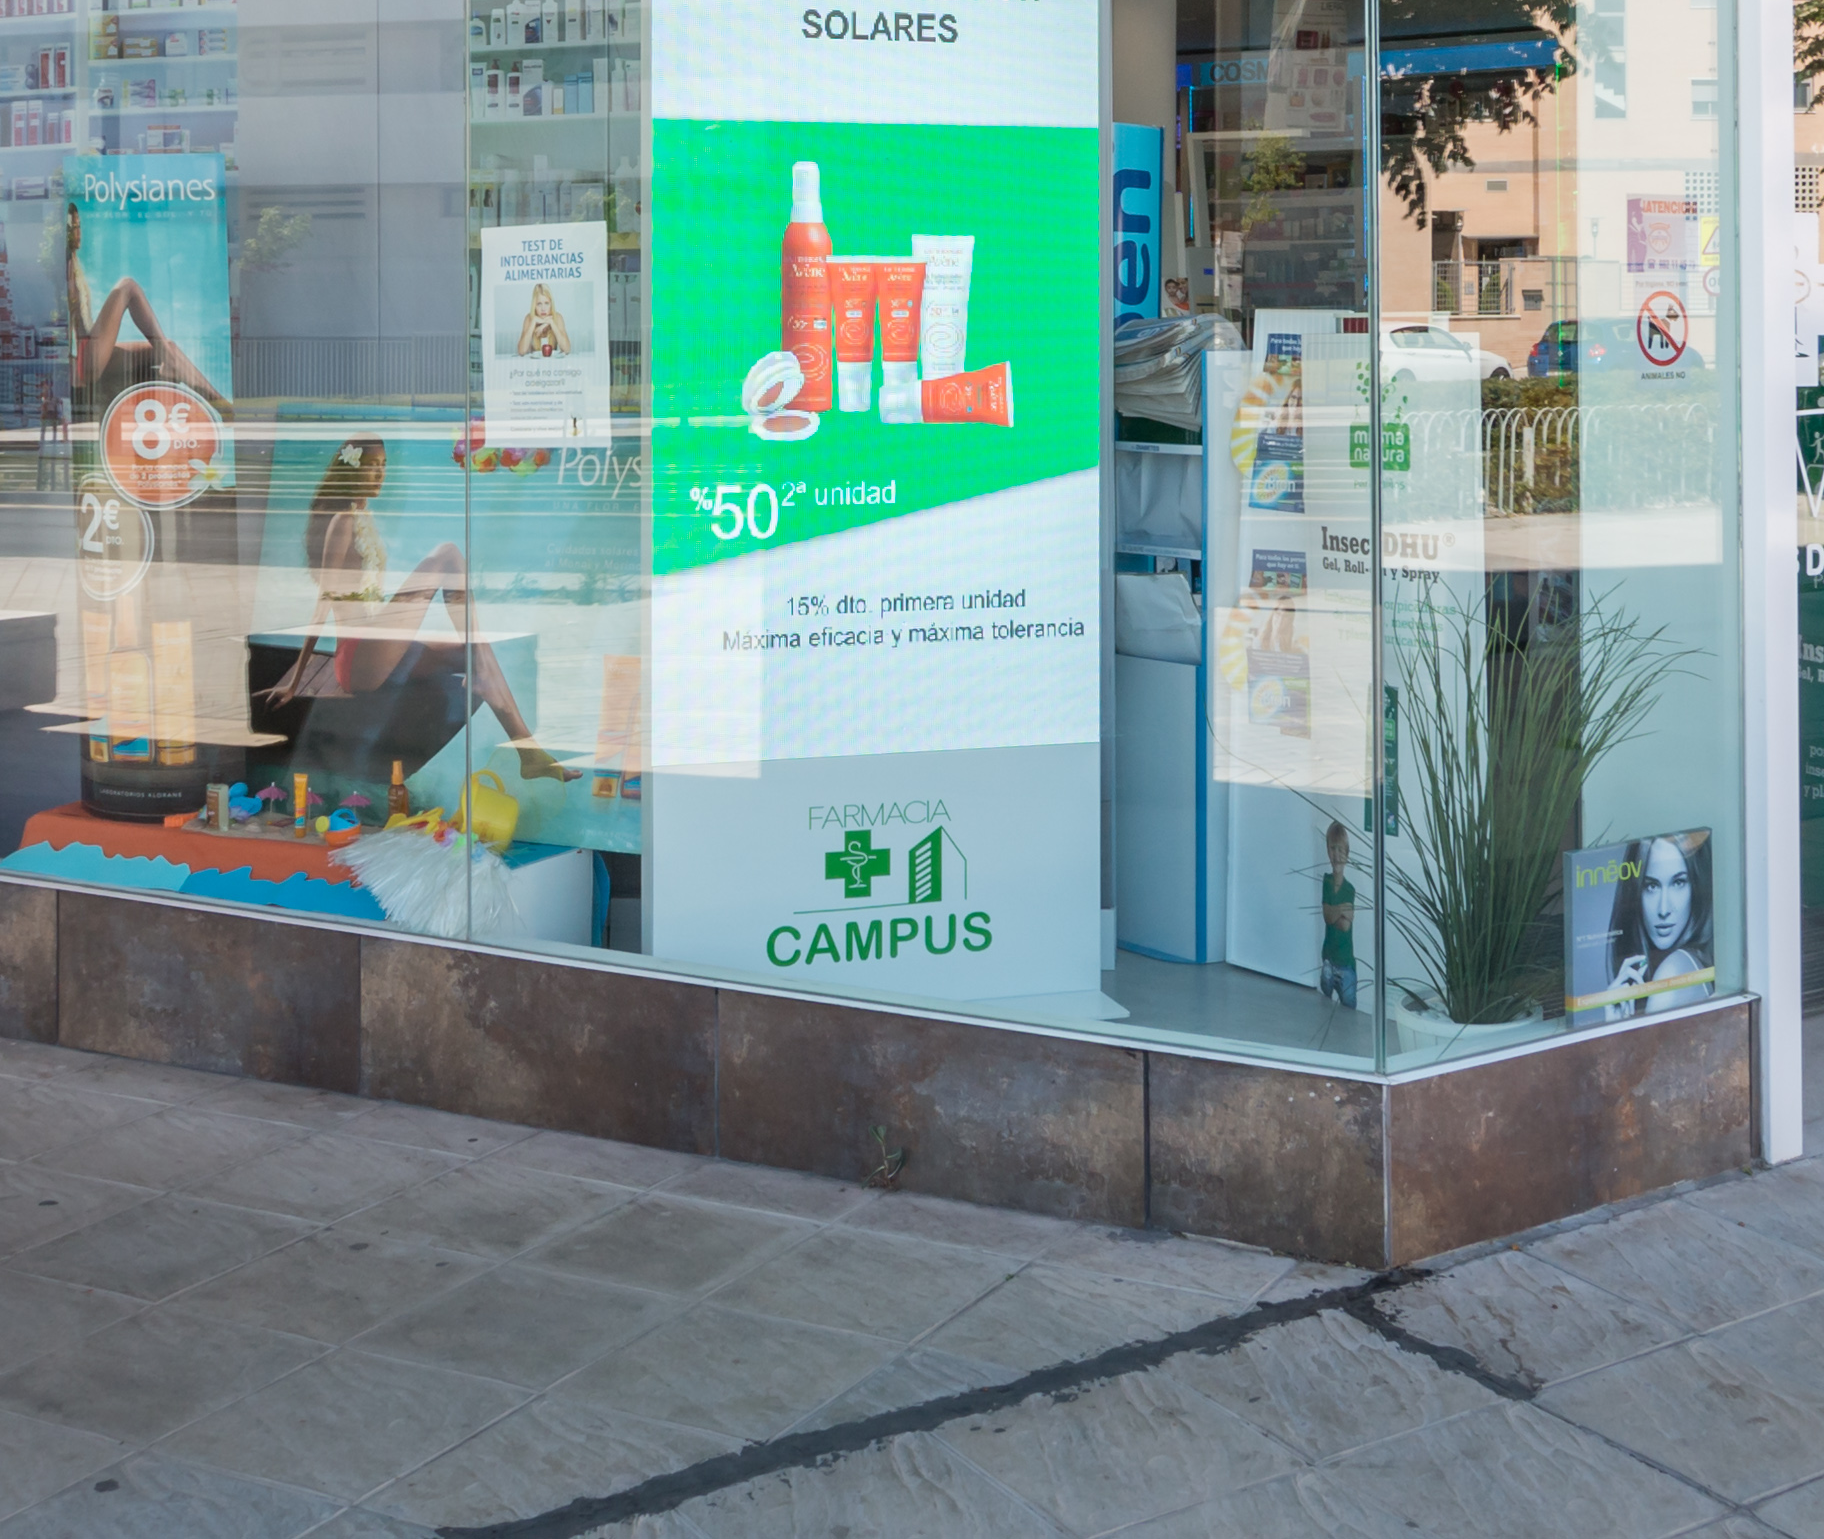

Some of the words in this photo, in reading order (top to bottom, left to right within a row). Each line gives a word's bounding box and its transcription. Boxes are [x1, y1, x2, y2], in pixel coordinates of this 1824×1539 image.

[801, 10, 959, 44] SOLARES
[84, 171, 216, 211] Polysianes
[521, 239, 546, 252] TEST
[549, 238, 564, 251] DE
[500, 252, 584, 268] INTOLERANCIAS
[504, 266, 582, 282] ALIMENTARIAS
[1641, 372, 1674, 380] ANIMALES
[1676, 371, 1686, 379] NO
[1353, 446, 1406, 464] naura
[814, 480, 897, 508] unidad
[1323, 556, 1341, 573] Gel,
[1402, 565, 1440, 584] Spray
[786, 595, 830, 617] 15%
[880, 592, 954, 619] primera
[961, 589, 1026, 611] unidad
[722, 629, 801, 652] Máxima
[808, 625, 884, 648] eficacia
[891, 628, 903, 648] y
[908, 622, 985, 644] máxima
[991, 617, 1085, 641] tolerancia
[808, 798, 952, 831] FARMACIA
[766, 910, 993, 967] CAMPUS
